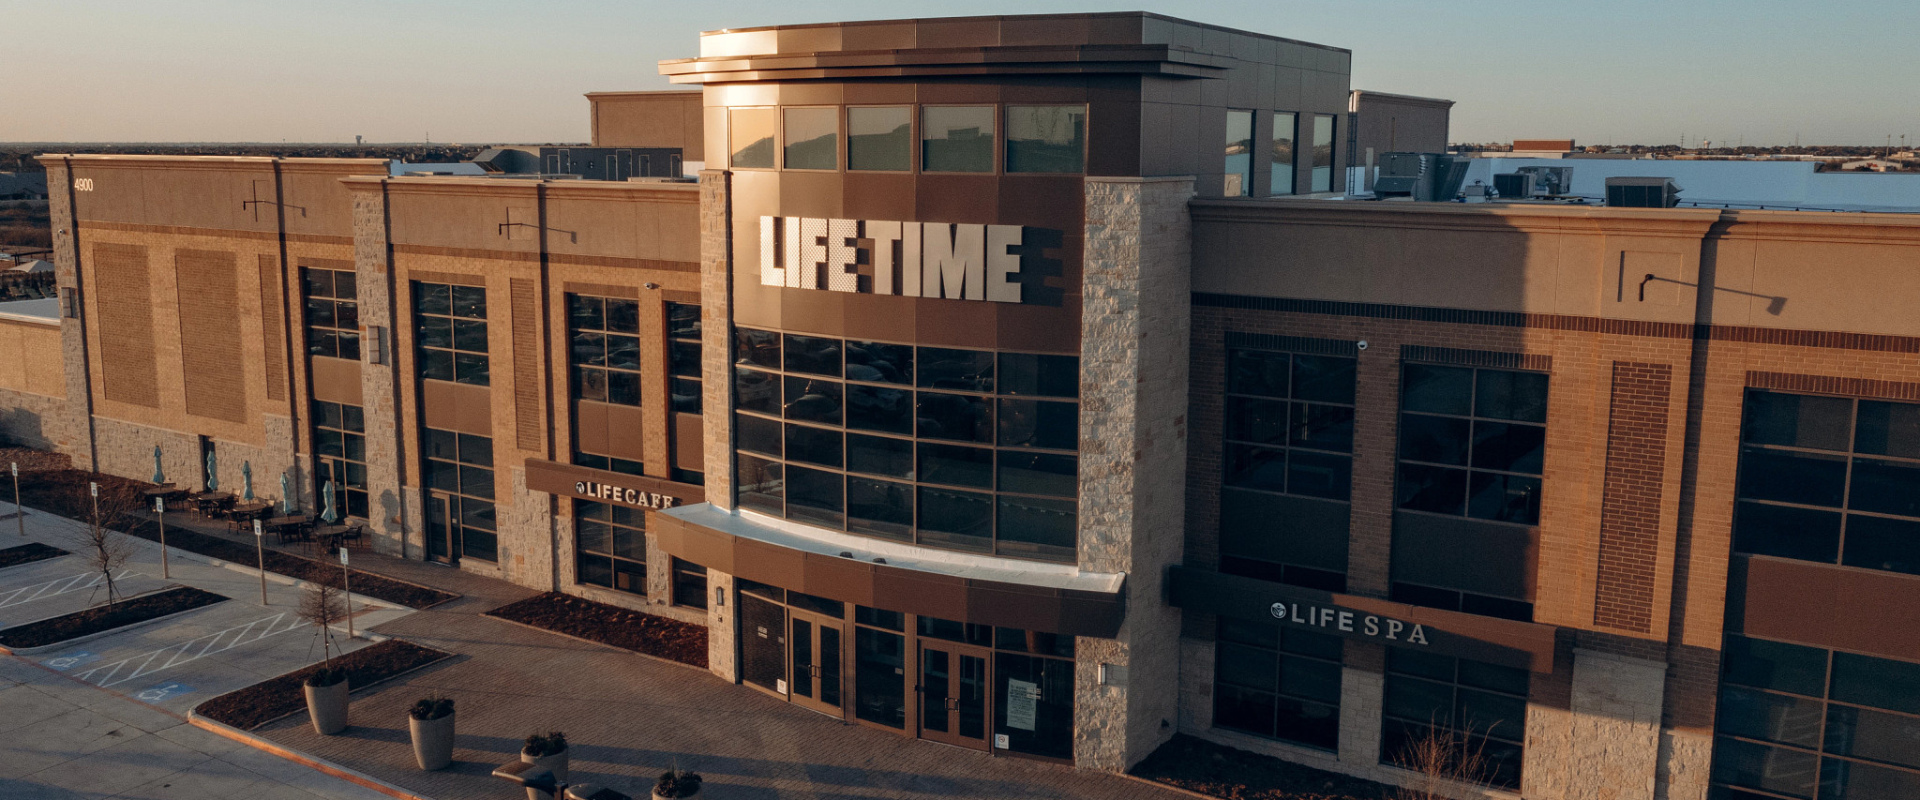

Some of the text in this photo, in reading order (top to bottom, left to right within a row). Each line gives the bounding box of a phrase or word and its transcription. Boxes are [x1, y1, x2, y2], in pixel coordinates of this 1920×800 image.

[74, 178, 94, 191] 4900
[1291, 603, 1429, 645] LIFE SPA
